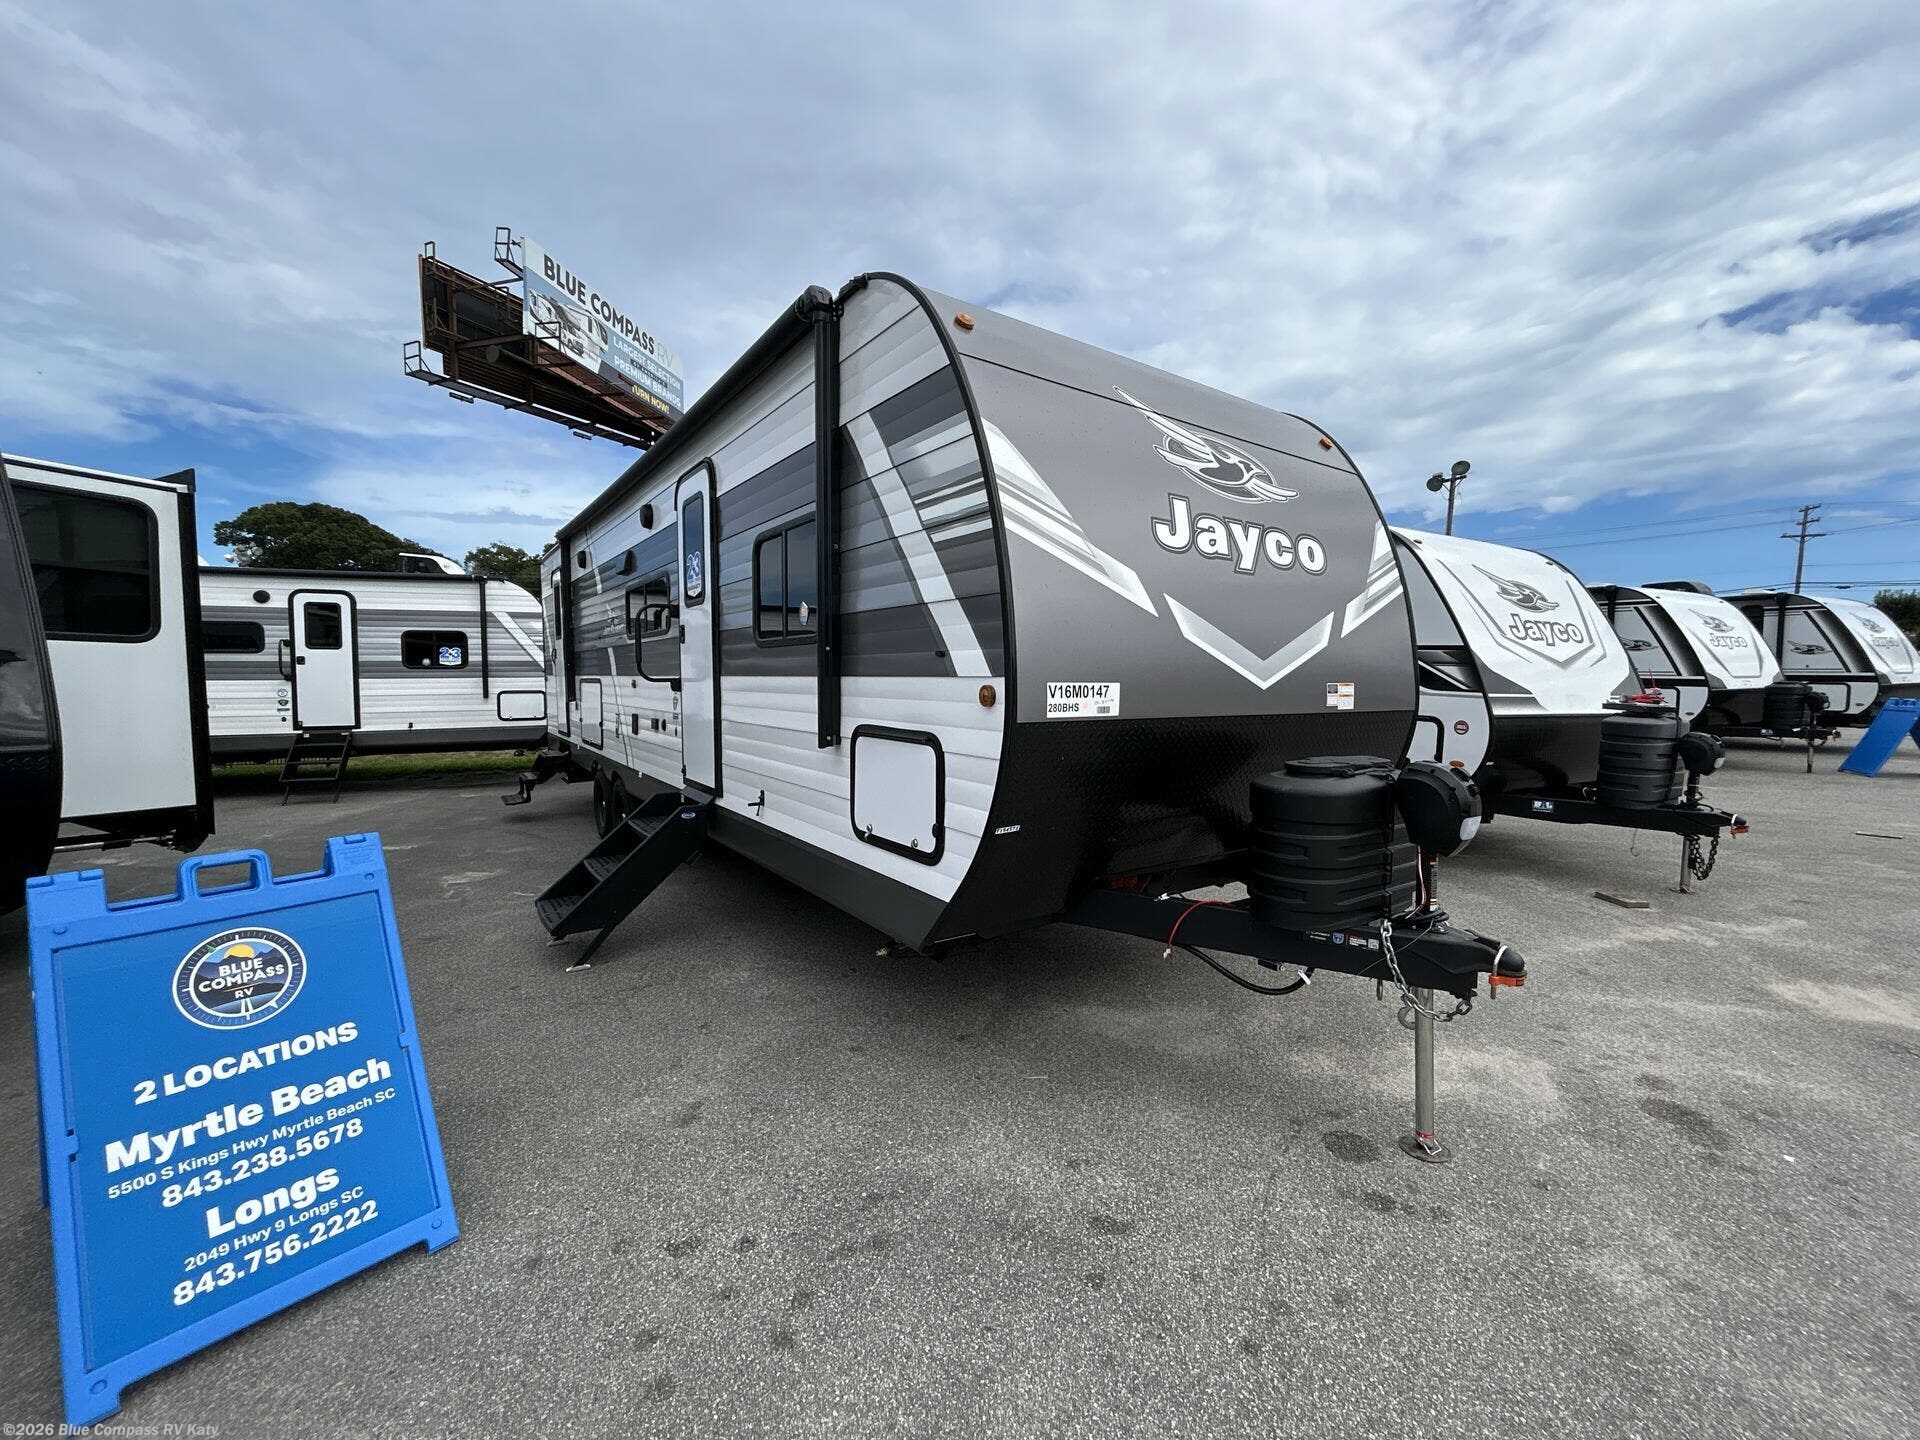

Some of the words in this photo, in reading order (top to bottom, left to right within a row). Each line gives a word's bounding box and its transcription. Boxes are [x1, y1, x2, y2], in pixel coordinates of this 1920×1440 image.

[543, 253, 586, 305] BLUE
[590, 293, 655, 355] COMPASS
[657, 342, 673, 367] RV
[613, 336, 646, 365] LARGEST
[647, 359, 681, 389] SELECTION
[614, 355, 651, 388] PREMIUM
[652, 383, 681, 407] BRANDS
[1150, 493, 1327, 576] Jayco
[1508, 613, 1584, 647] Jayco
[1709, 632, 1748, 650] Jayco
[1048, 685, 1110, 699] V16M0147
[1048, 703, 1079, 712] 280BHS
[198, 964, 285, 992] COMPASS
[218, 957, 264, 977] BLUE
[234, 987, 254, 999] RV
[133, 1080, 157, 1105] 2
[163, 1022, 358, 1097] LOCATIONS
[105, 1103, 263, 1173] Myrtle
[270, 1058, 392, 1117] Beach
[107, 1172, 157, 1199] 5500
[160, 1166, 174, 1180] S
[178, 1150, 229, 1175] Kings
[232, 1133, 269, 1155] Hwy
[272, 1115, 324, 1141] Myrtle
[326, 1097, 373, 1121] Beach
[374, 1087, 396, 1103] SC
[162, 1118, 364, 1208] 843.238.5678
[184, 1242, 230, 1272] 2049
[233, 1226, 271, 1250] Hwy
[274, 1219, 286, 1232] 9
[289, 1197, 338, 1227] Longs
[341, 1186, 364, 1204] SC
[206, 1168, 341, 1239] Longs
[173, 1199, 379, 1306] 843.756.2222
